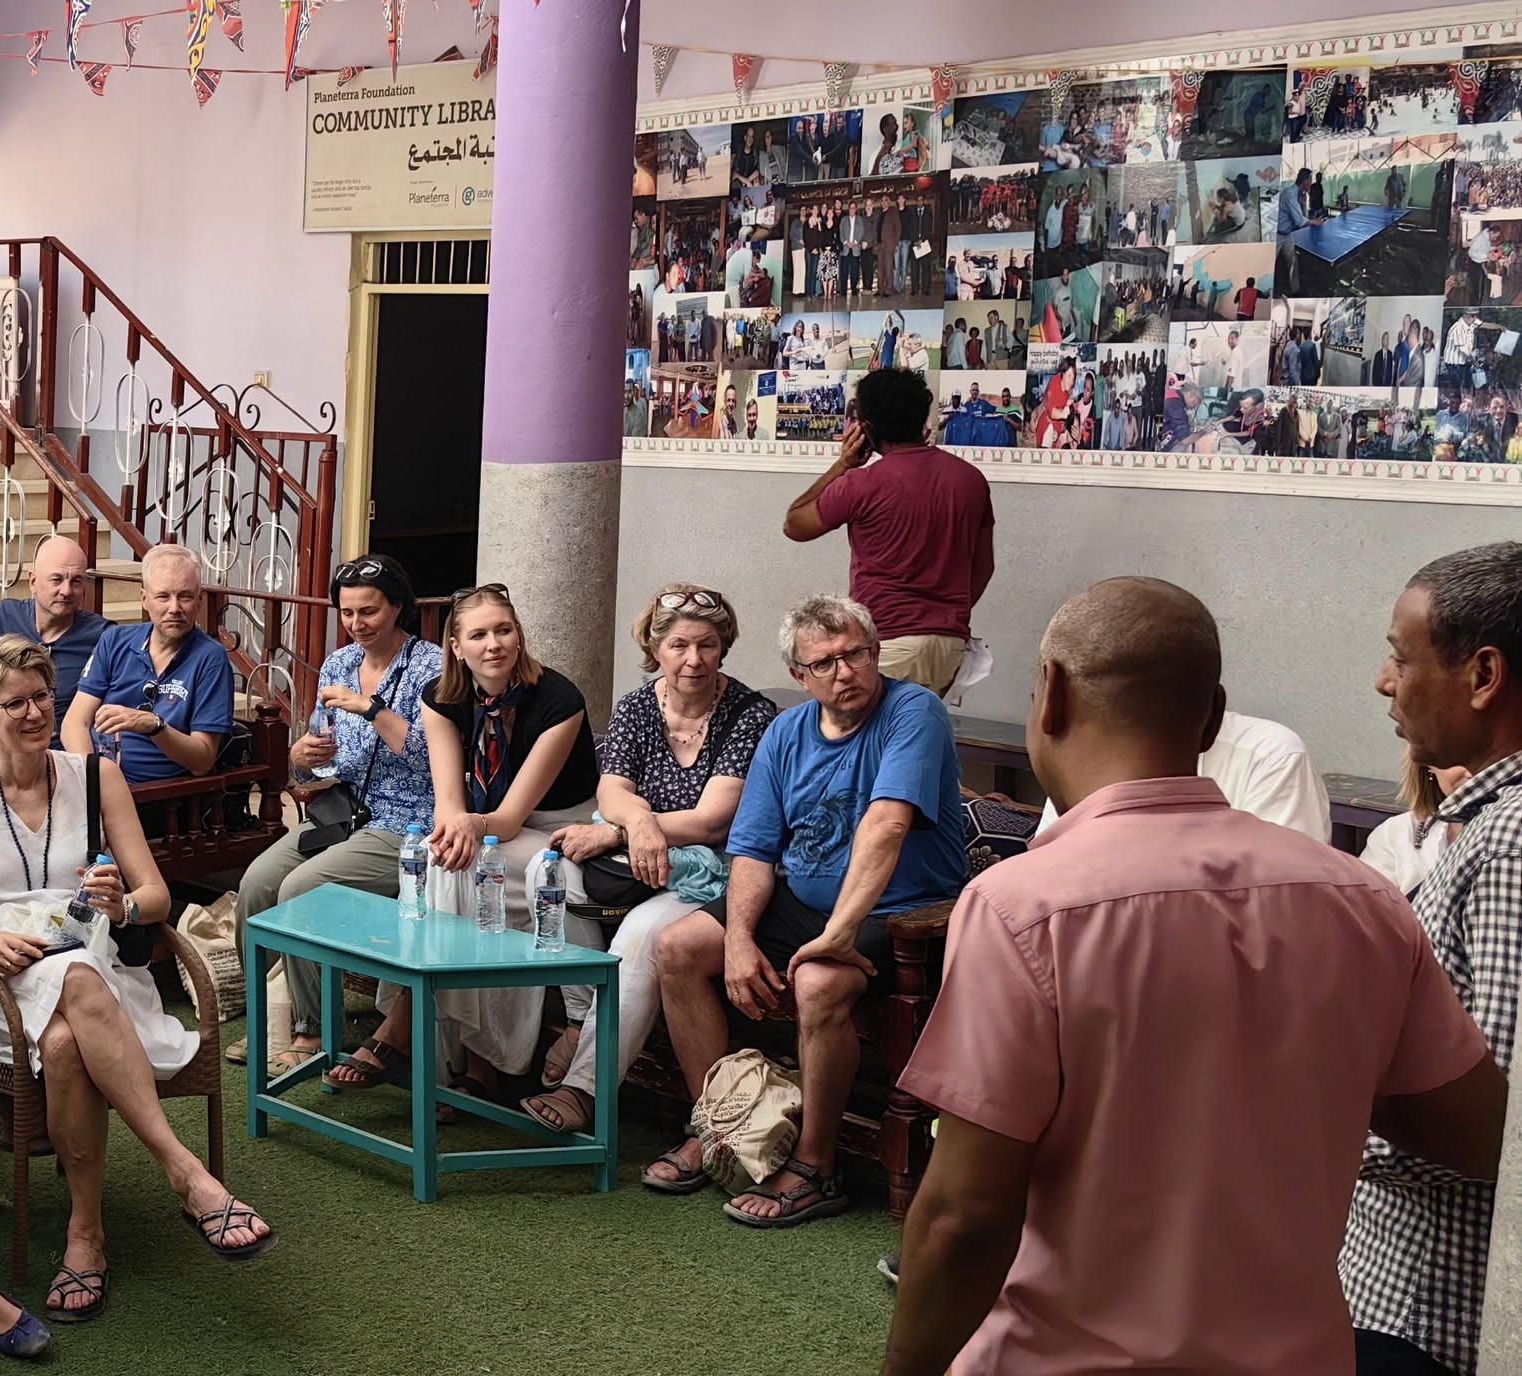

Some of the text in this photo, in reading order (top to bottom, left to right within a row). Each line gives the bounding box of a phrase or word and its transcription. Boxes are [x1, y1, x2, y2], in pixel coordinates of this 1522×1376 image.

[314, 85, 415, 103] Planeterra Foundation
[313, 98, 496, 134] COMMUNITY LIBRA
[408, 137, 466, 171] المجتمع
